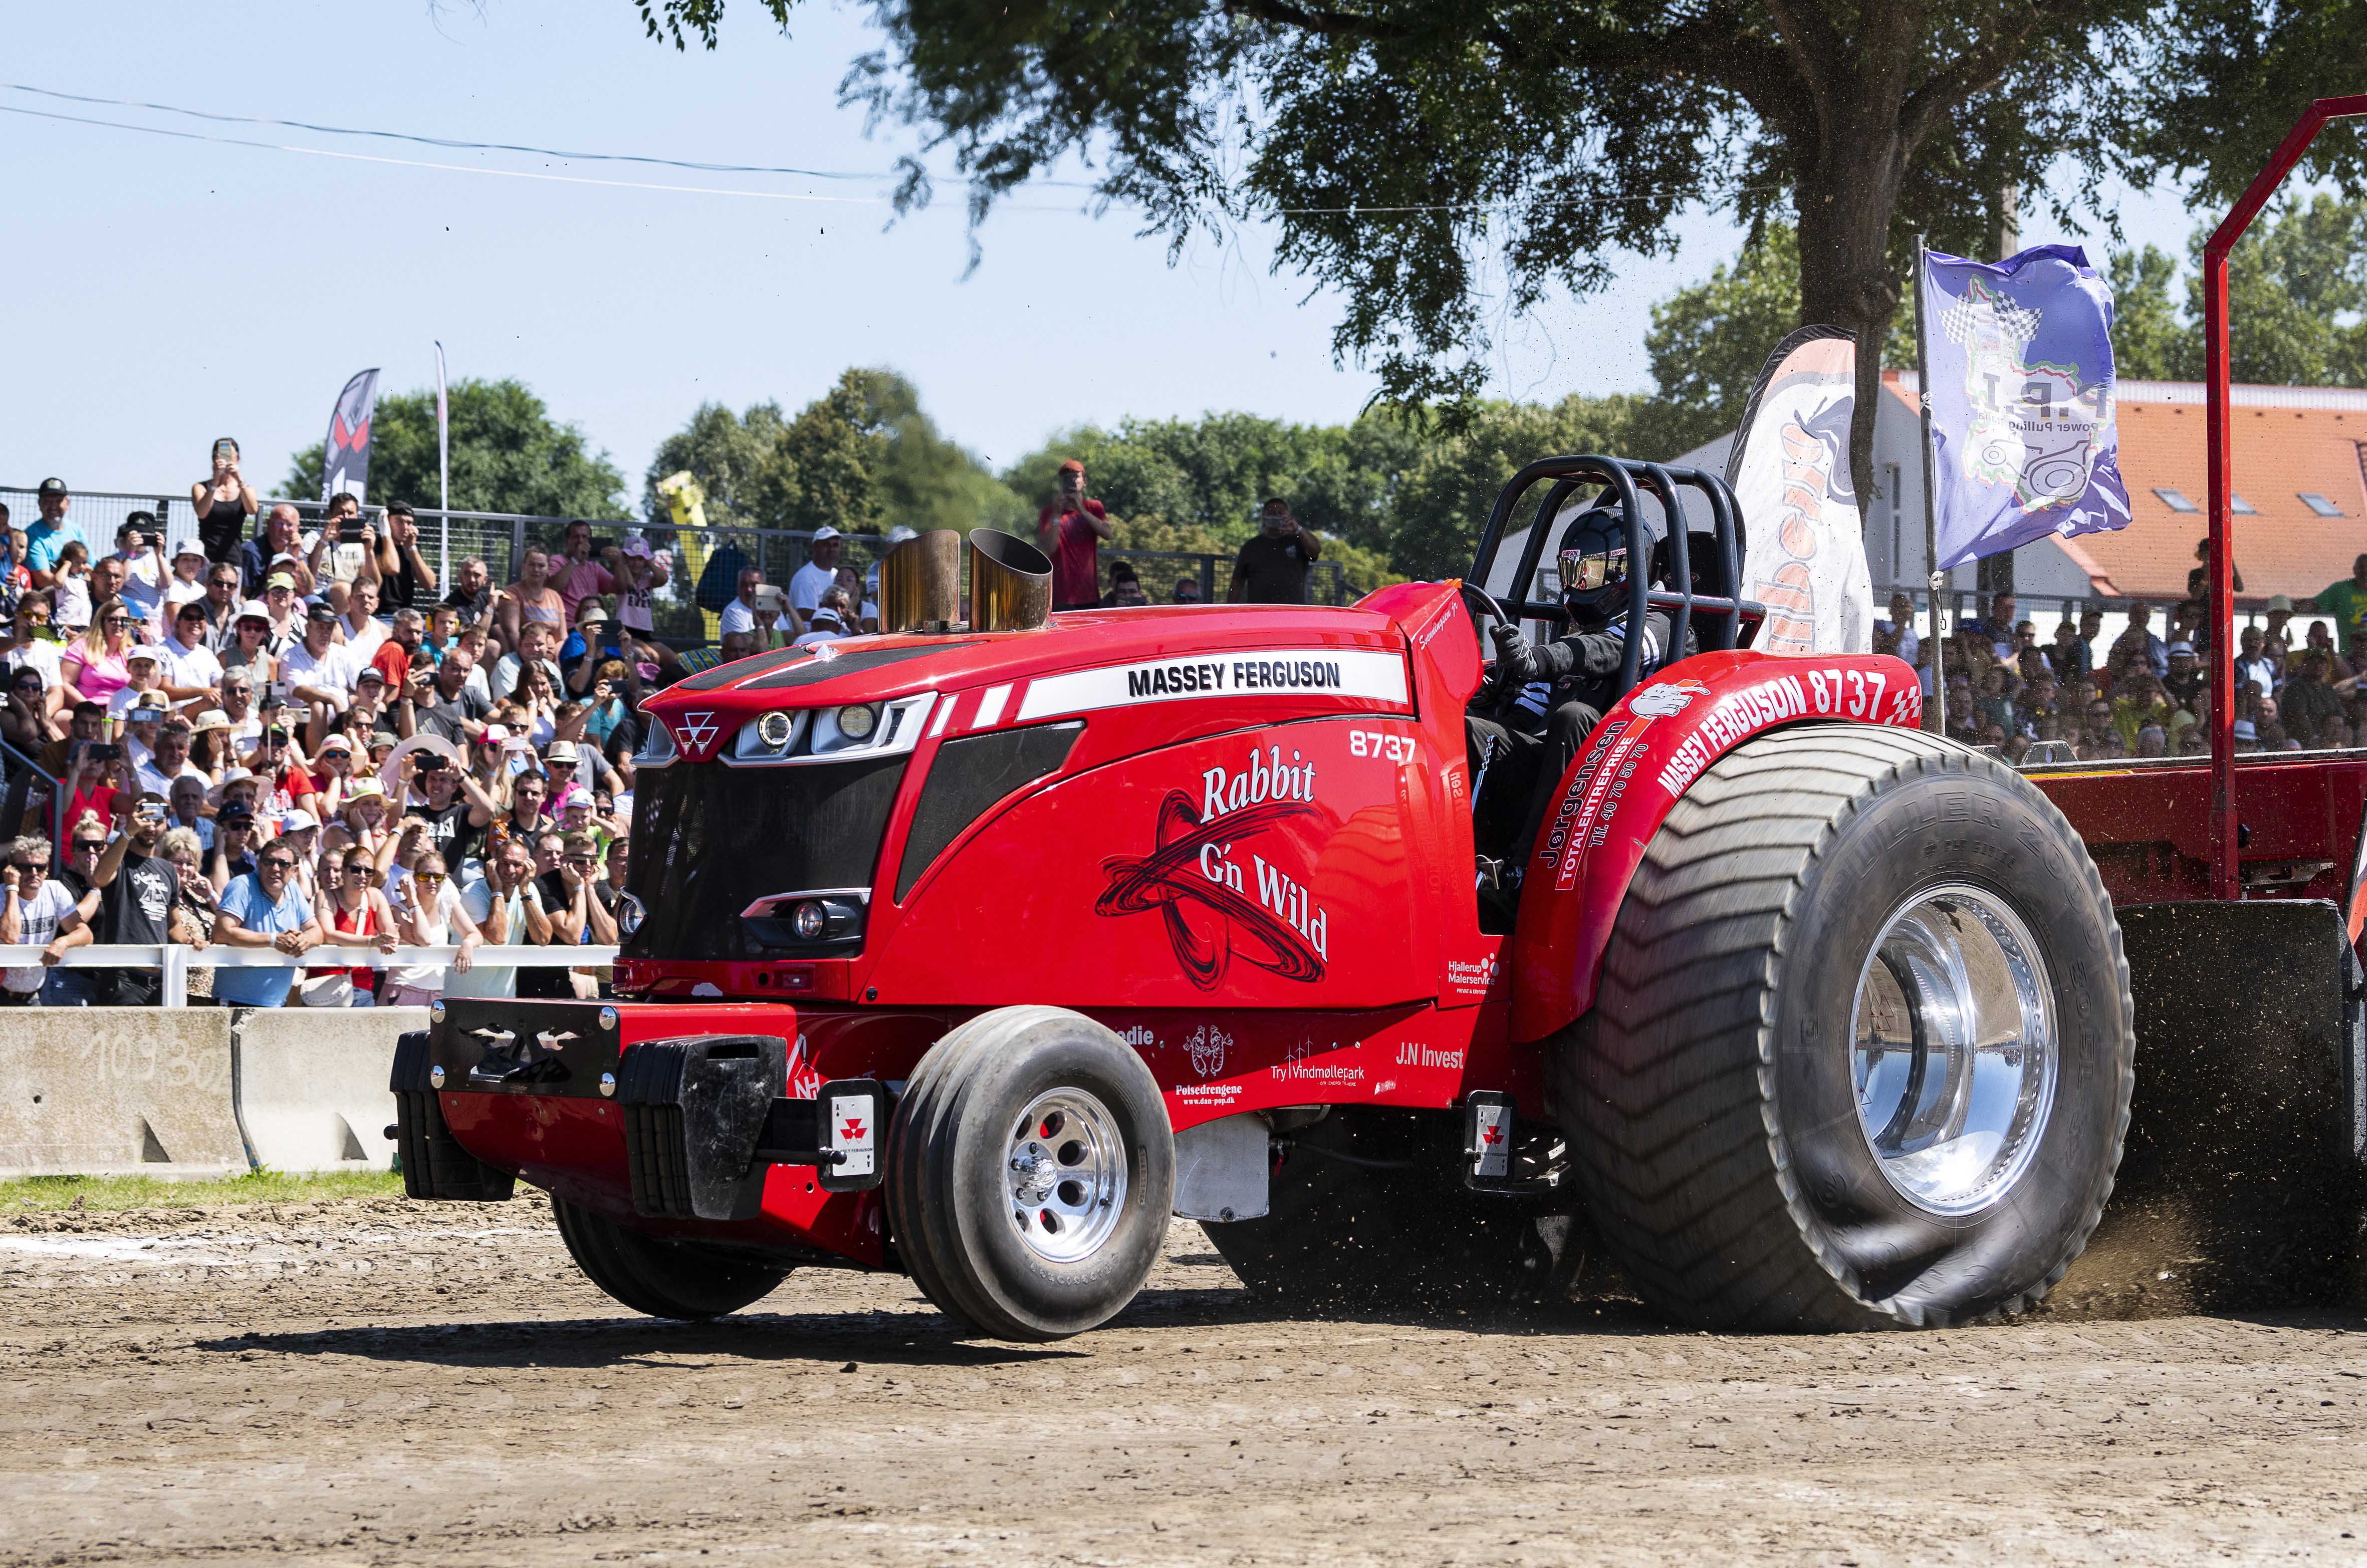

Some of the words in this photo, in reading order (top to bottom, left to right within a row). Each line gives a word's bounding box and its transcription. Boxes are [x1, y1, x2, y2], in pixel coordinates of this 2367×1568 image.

[1418, 611, 1451, 651] Svenningsen
[1128, 663, 1225, 697] MASSEY
[1234, 662, 1341, 688] FERGUSON
[1658, 730, 1712, 799] MASSEY
[1699, 675, 1807, 752] FERGUSON
[1808, 669, 1886, 720] 8737
[1349, 730, 1416, 762] 8737
[1630, 743, 1649, 759] 70
[1619, 761, 1637, 778] 50
[1200, 745, 1316, 824] Rabbit
[1539, 721, 1628, 869] Jørgensen
[1608, 780, 1626, 799] 70
[1561, 737, 1634, 882] TOTALENTREPRISE
[1601, 802, 1617, 821] 40
[1588, 825, 1609, 848] Tlf.
[1253, 854, 1328, 962] Wild
[1448, 972, 1495, 985] Malerservice
[1449, 961, 1482, 974] Hjallerup
[1395, 1042, 1418, 1066] J.N
[1421, 1043, 1464, 1069] Invest
[1271, 1066, 1286, 1082] Try
[1293, 1065, 1364, 1081] Vindmøllepark
[1176, 1085, 1242, 1096] Pølsedrengene
[1184, 1097, 1235, 1106] www.dan-pop.dk
